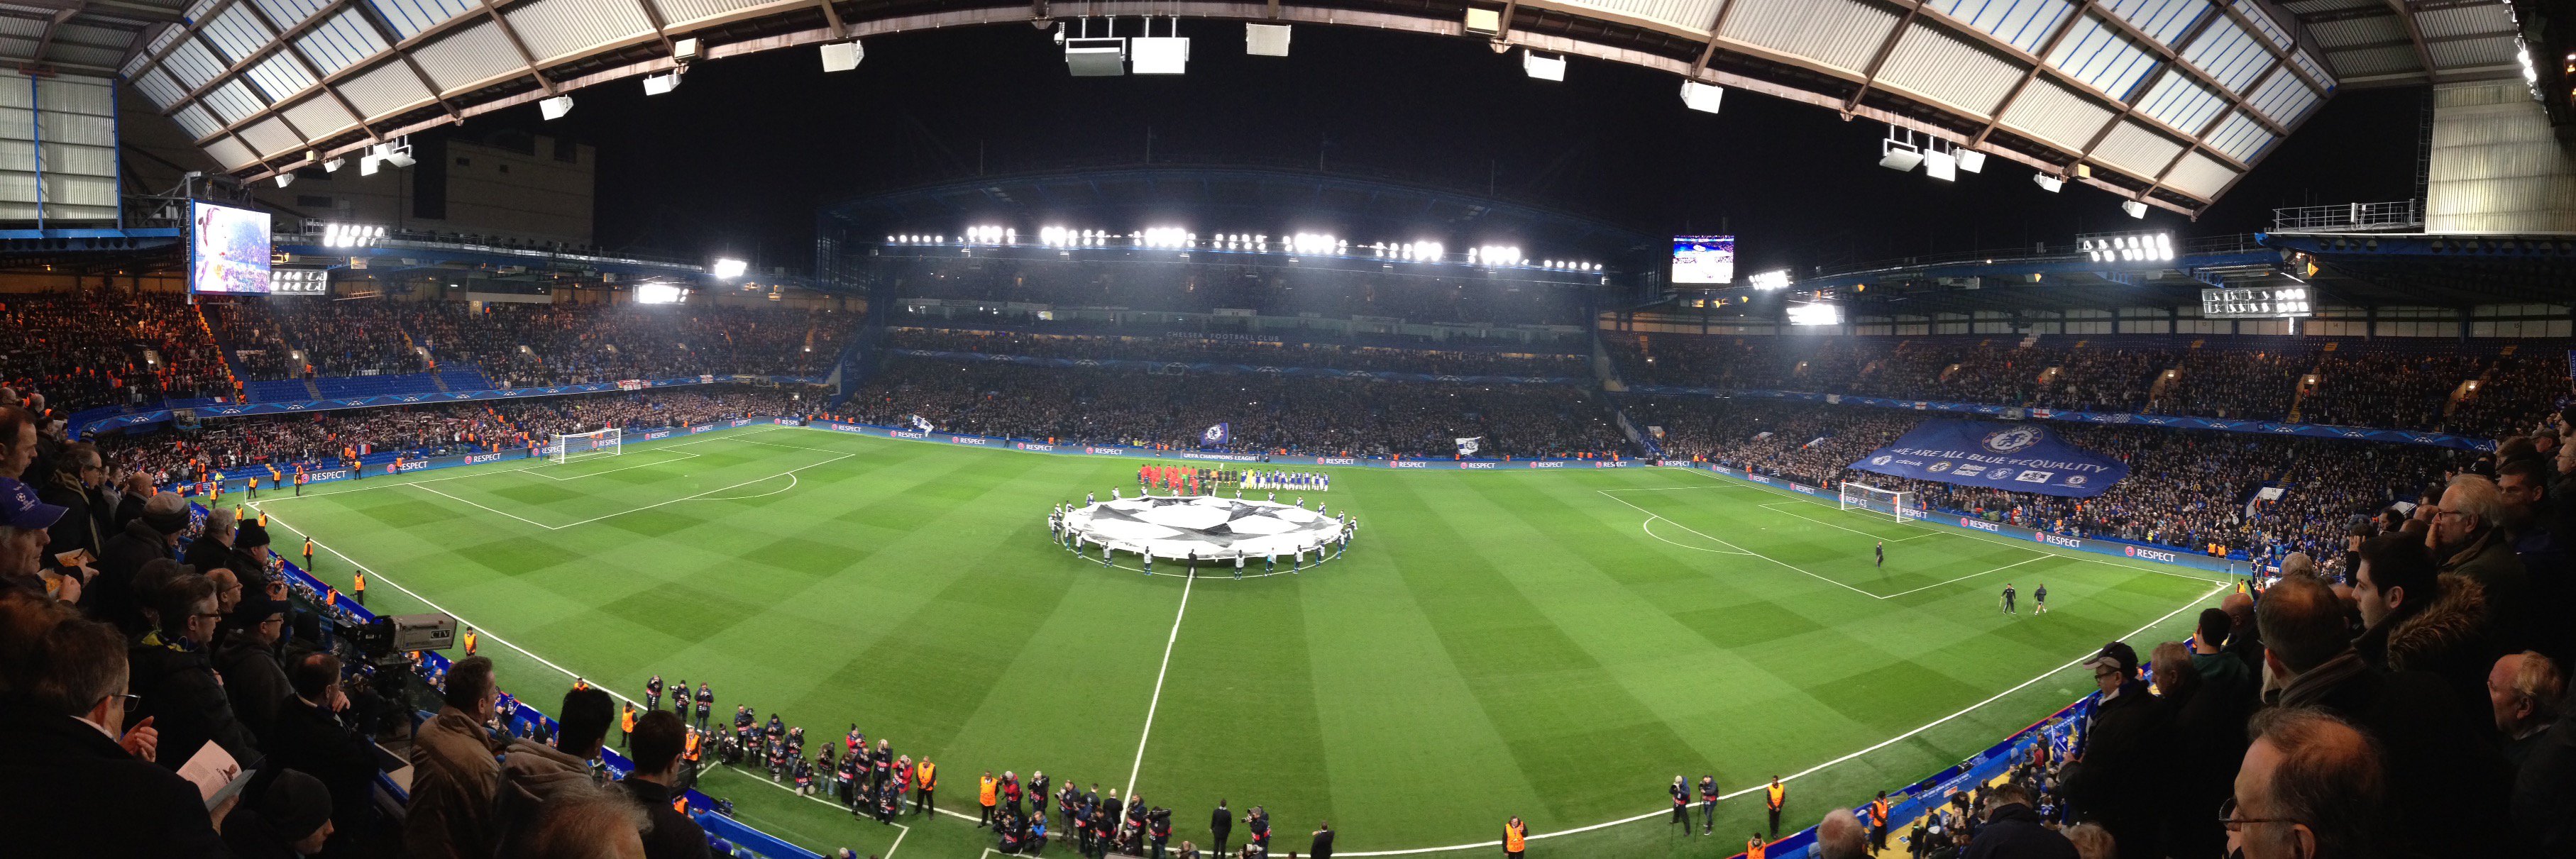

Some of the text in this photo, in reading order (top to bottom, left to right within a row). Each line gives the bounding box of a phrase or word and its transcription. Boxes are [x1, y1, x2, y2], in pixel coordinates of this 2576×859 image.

[696, 424, 713, 433] RESPECT
[838, 423, 862, 433] RESPECT
[651, 431, 670, 439] RESPECT
[960, 437, 986, 445] RESPECT
[1026, 443, 1053, 452] RESPECT
[473, 453, 501, 462] RESPECT
[1966, 454, 2008, 463] BLUE
[2009, 460, 2109, 473] #EQUALITY
[1717, 466, 1732, 475] RESPECT
[312, 470, 346, 482] RESPECT
[1753, 475, 1770, 484] RESPECT
[1795, 484, 1815, 494] RESPECT
[1846, 497, 1868, 507] RESPCT
[1969, 519, 1999, 532] RESPECT
[2046, 535, 2081, 548] RESPECT
[2137, 548, 2176, 562] RESPECT
[431, 630, 449, 638] CTV
